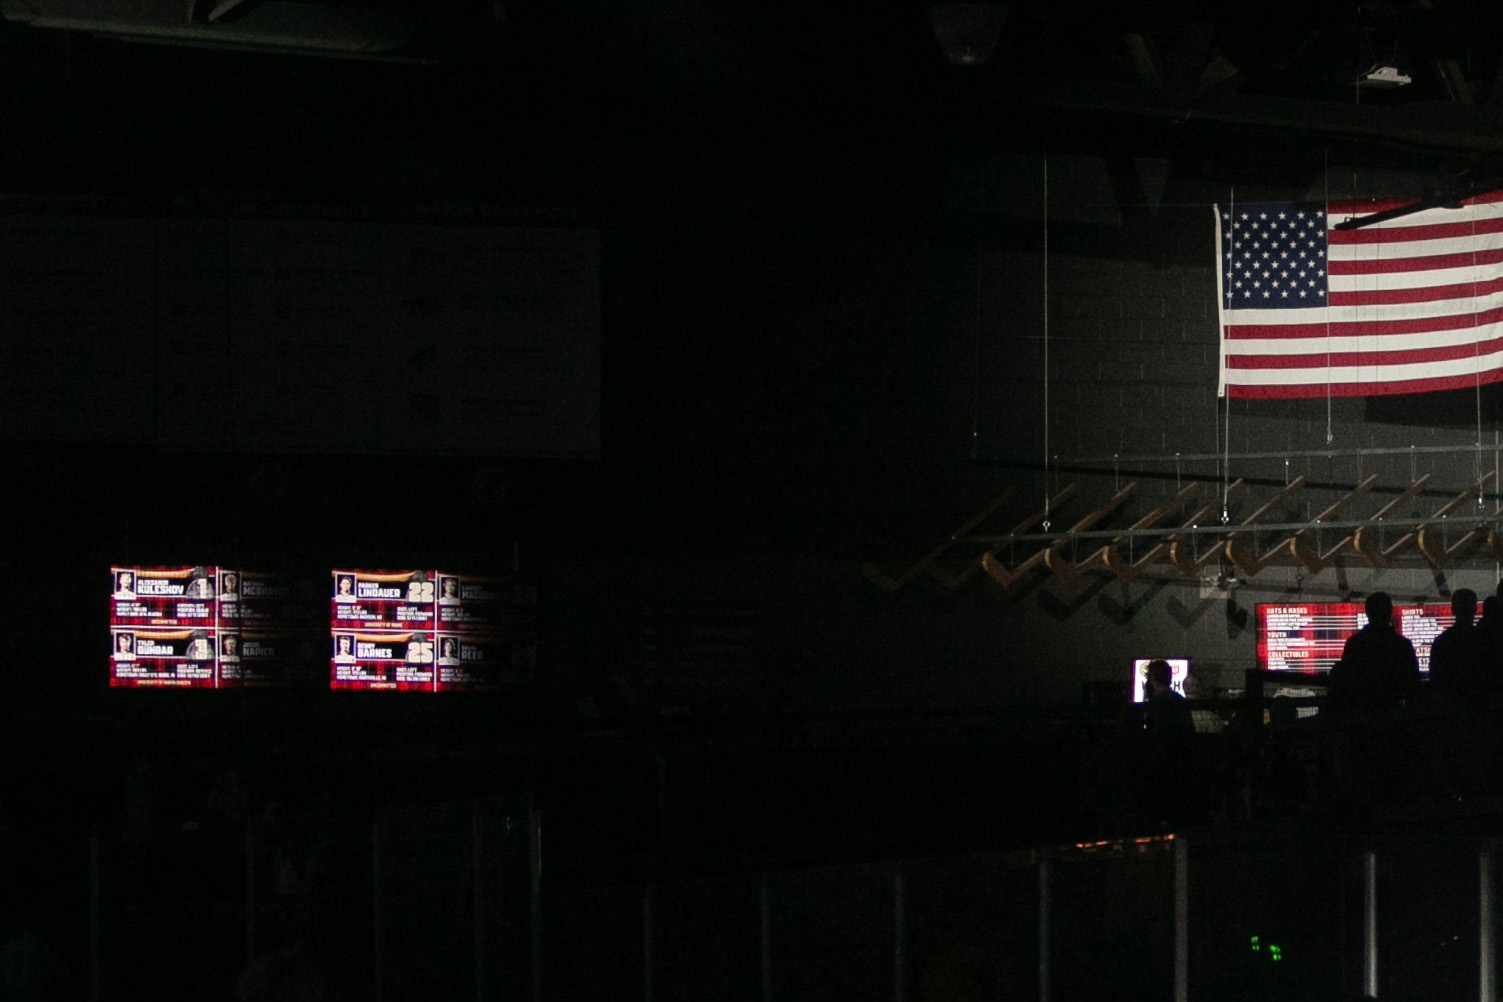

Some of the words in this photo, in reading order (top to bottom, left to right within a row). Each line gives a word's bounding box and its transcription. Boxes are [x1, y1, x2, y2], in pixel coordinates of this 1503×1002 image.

[358, 589, 401, 598] LINDAUER
[409, 582, 434, 602] 22
[138, 646, 174, 655] DUNBAR
[358, 649, 392, 658] BARNES
[408, 642, 433, 663] 25
